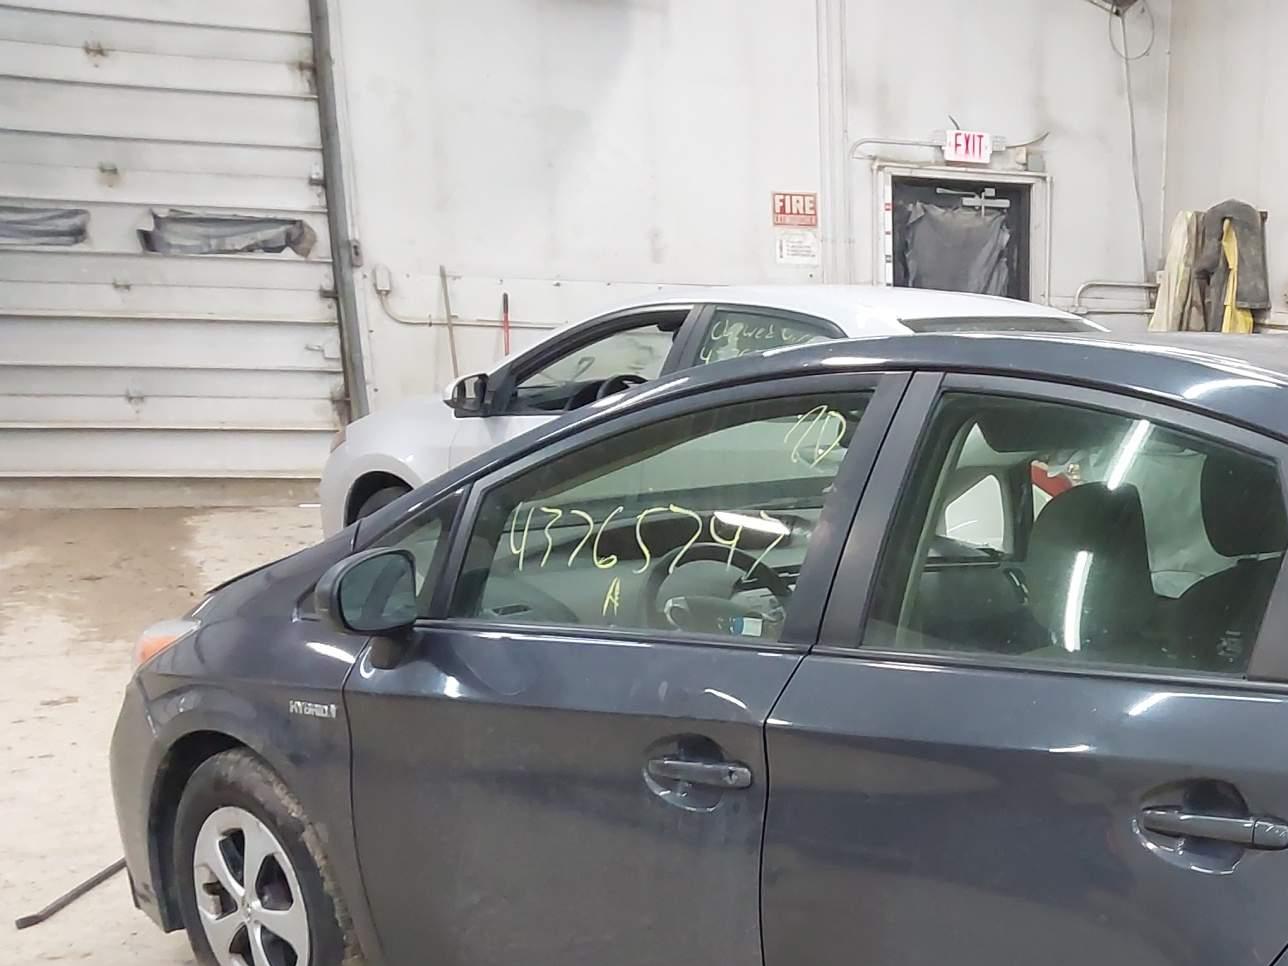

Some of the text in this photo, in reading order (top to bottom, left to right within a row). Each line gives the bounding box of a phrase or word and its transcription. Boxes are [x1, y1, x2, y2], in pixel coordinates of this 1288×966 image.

[954, 132, 984, 158] EXIT
[774, 194, 816, 214] FIRE
[510, 502, 792, 582] 43765747
[603, 576, 621, 616] A
